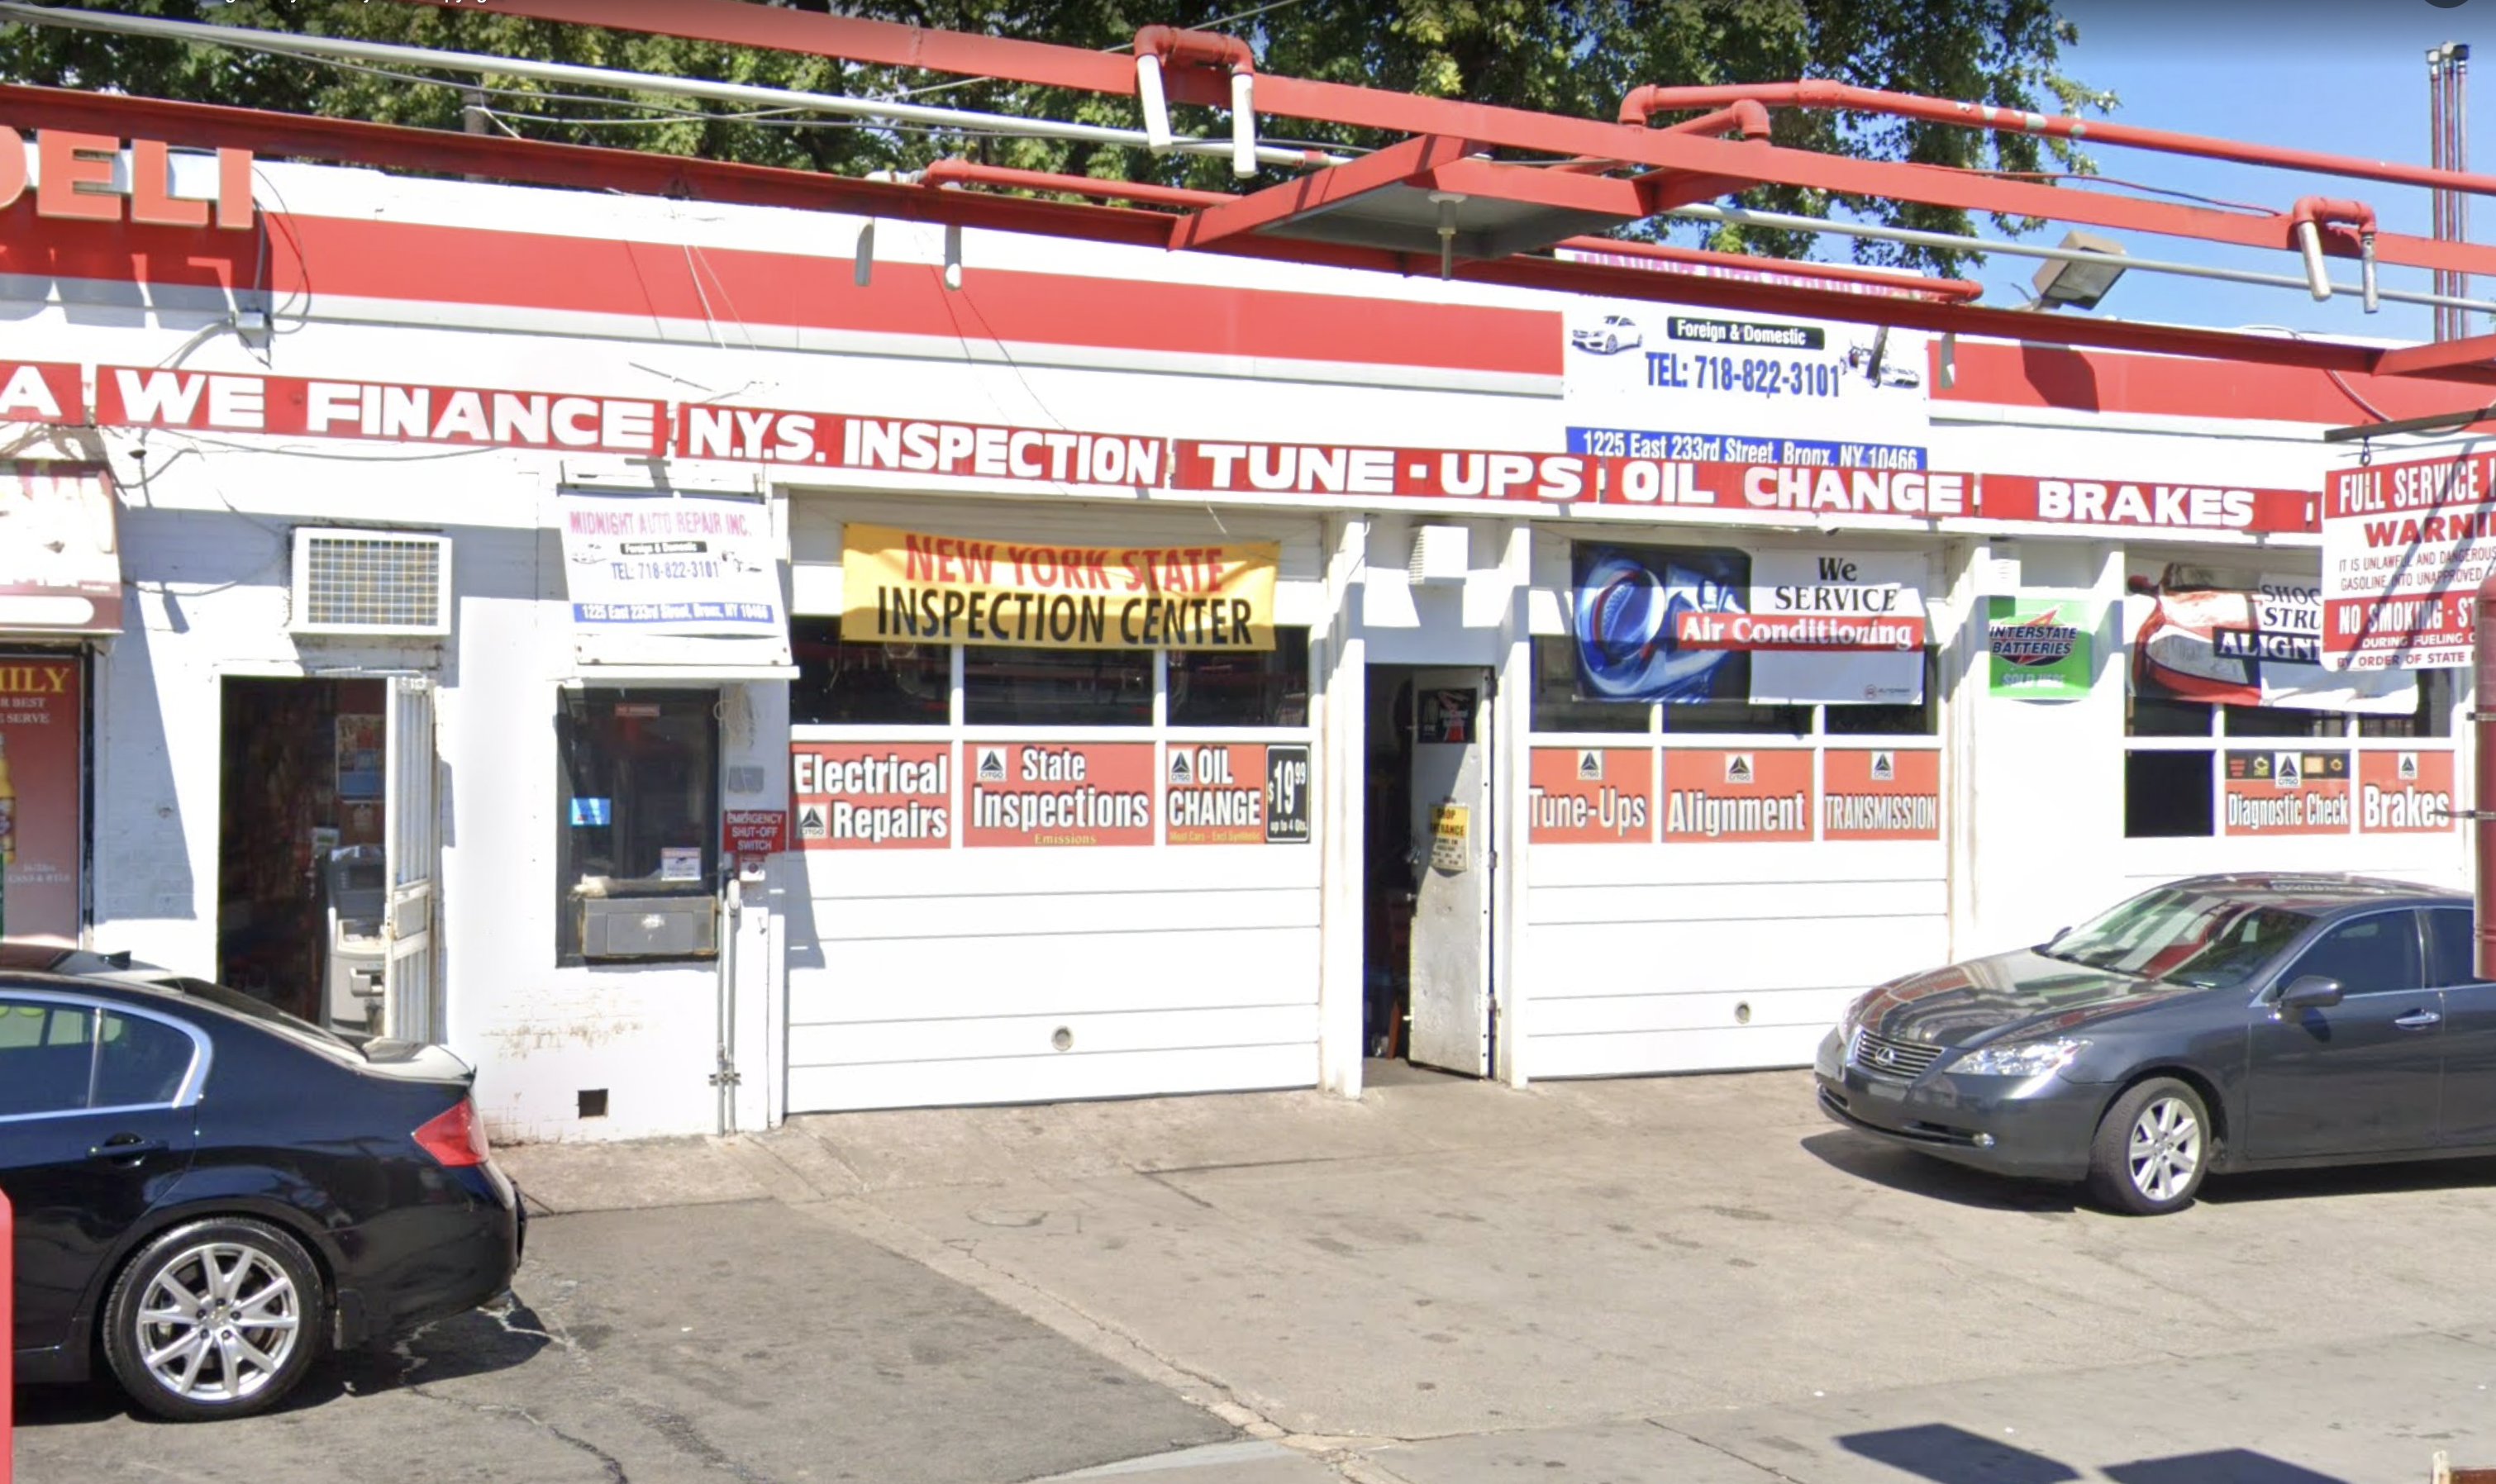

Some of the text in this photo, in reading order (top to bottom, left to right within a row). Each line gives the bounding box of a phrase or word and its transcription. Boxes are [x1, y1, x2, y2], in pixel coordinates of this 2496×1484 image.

[1677, 320, 1806, 345] Foreign & Domestic
[1646, 351, 1838, 397] TEL: 718-822-3101
[115, 369, 654, 449] WE FINANCE
[689, 408, 1159, 484] N.Y.S. INSPECTION
[1584, 430, 1625, 456] 1225
[1630, 433, 1667, 458] East
[1672, 435, 1720, 460] 233rd
[1841, 445, 1865, 467] NY
[1869, 446, 1917, 469] 10466
[1622, 460, 1962, 514] OIL CHANGE
[2039, 481, 2254, 526] BRAKES
[2340, 471, 2385, 513] FULL
[2394, 459, 2479, 507] SERVICE
[569, 511, 751, 537] MIDNIGHT AUTO REPAIR INC.
[611, 561, 719, 580] TEL: 718-822-3101
[905, 534, 1223, 592] NEW YORK STATE
[1819, 557, 1856, 582] We
[2339, 559, 2346, 573] IT
[2351, 558, 2360, 572] IS
[2364, 552, 2412, 571] UNLAWFUL
[2417, 552, 2436, 565] AND
[2341, 574, 2386, 591] GASOLINE
[2392, 573, 2412, 587] INTO
[2417, 568, 2483, 586] UNAPPROVED
[877, 586, 1252, 645] INSPECTION CENTER
[1775, 586, 1898, 612] SERVICE
[2339, 604, 2361, 635] NO
[2369, 598, 2444, 634] SMOKING
[1683, 616, 1911, 649] Air Conditioning
[1990, 625, 2077, 639] INTERSTATE
[1993, 642, 2071, 654] BATTERIES
[2363, 635, 2408, 649] DURING
[2414, 633, 2463, 646] FUELING
[2337, 656, 2350, 668] BY
[2359, 654, 2399, 667] ORDER
[2406, 653, 2420, 664] OF
[2427, 651, 2465, 664] STATE
[6, 713, 50, 725] SERVE
[793, 753, 948, 794] Electrical
[1022, 747, 1085, 781] State
[1198, 748, 1235, 784] OIL
[727, 812, 783, 824] EMERGENCY
[832, 800, 948, 843] Repairs
[973, 785, 1150, 833] Inspections
[1169, 788, 1262, 826] CHANGE
[1529, 787, 1646, 836] Tune-Ups
[1667, 790, 1805, 837] Alignment
[1826, 794, 1936, 830] TRANSMISSION
[2228, 792, 2348, 830] Diagnostic Check
[2364, 786, 2450, 827] Brakes
[732, 826, 779, 837] SHUT-OFF
[737, 840, 772, 850] SWITCH
[1035, 833, 1097, 844] Emissions
